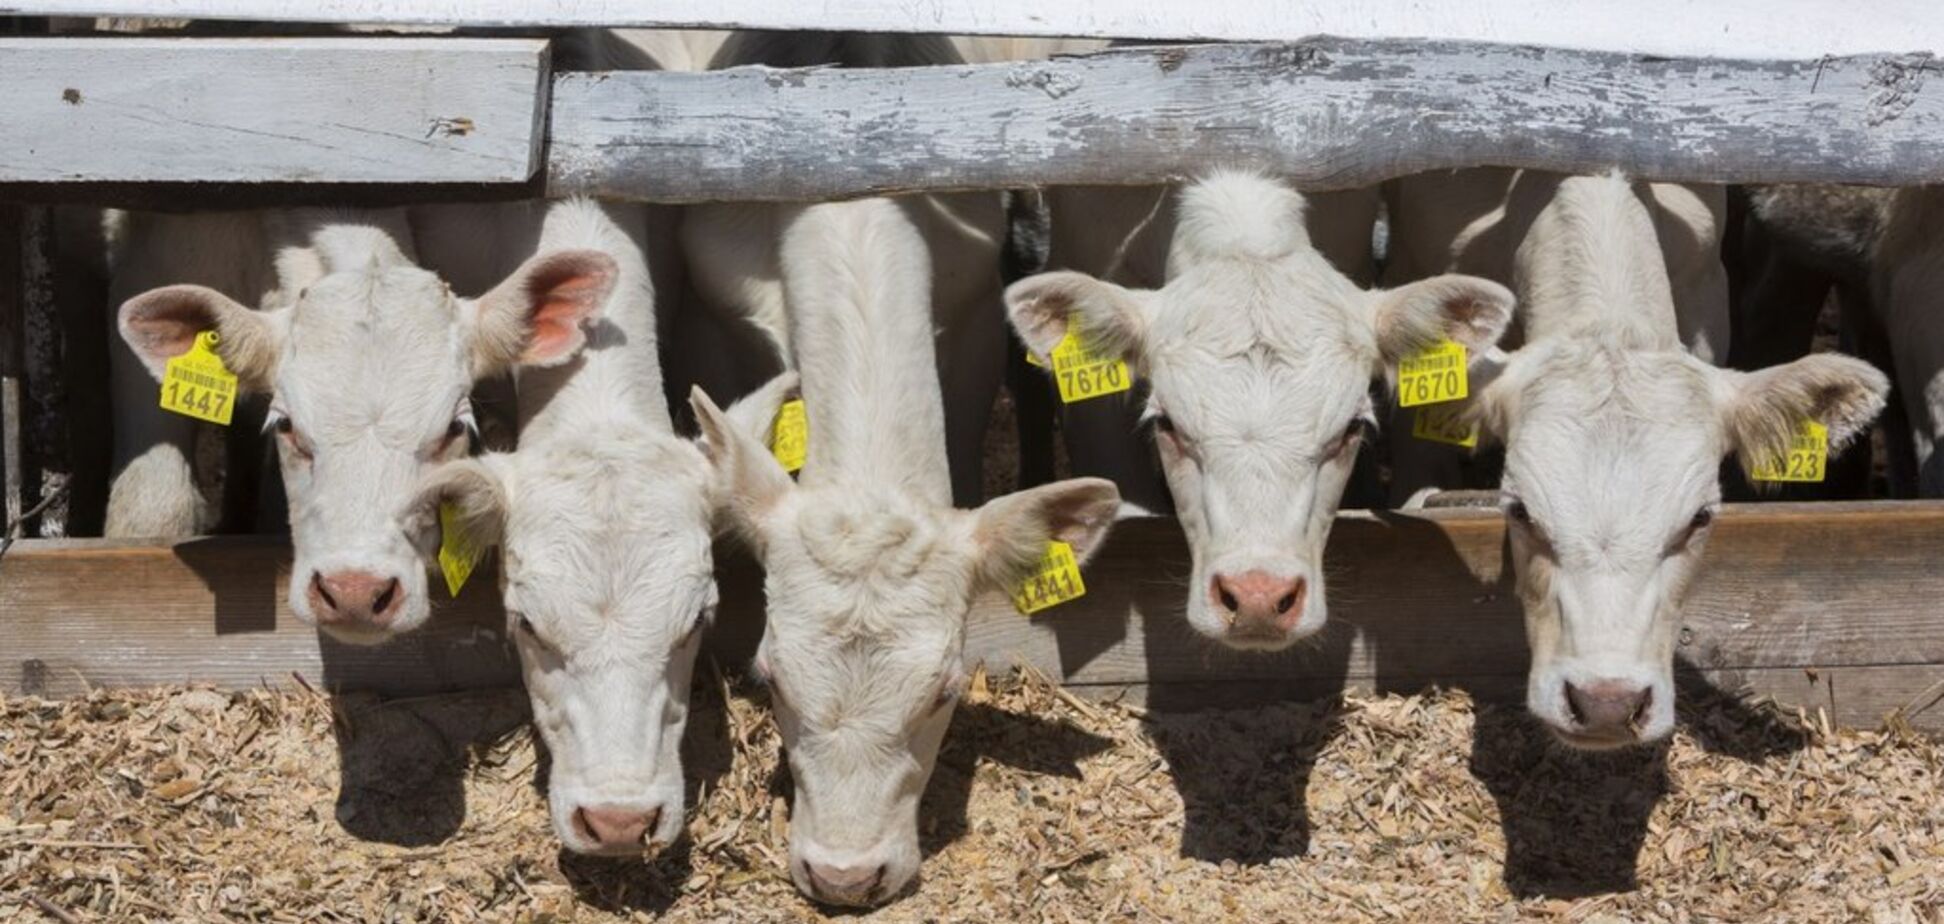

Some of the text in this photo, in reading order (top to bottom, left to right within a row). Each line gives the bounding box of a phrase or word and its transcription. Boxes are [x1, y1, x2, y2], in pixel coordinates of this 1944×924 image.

[1061, 362, 1121, 397] 7670
[1402, 370, 1459, 404] 7670
[169, 381, 228, 418] 1447
